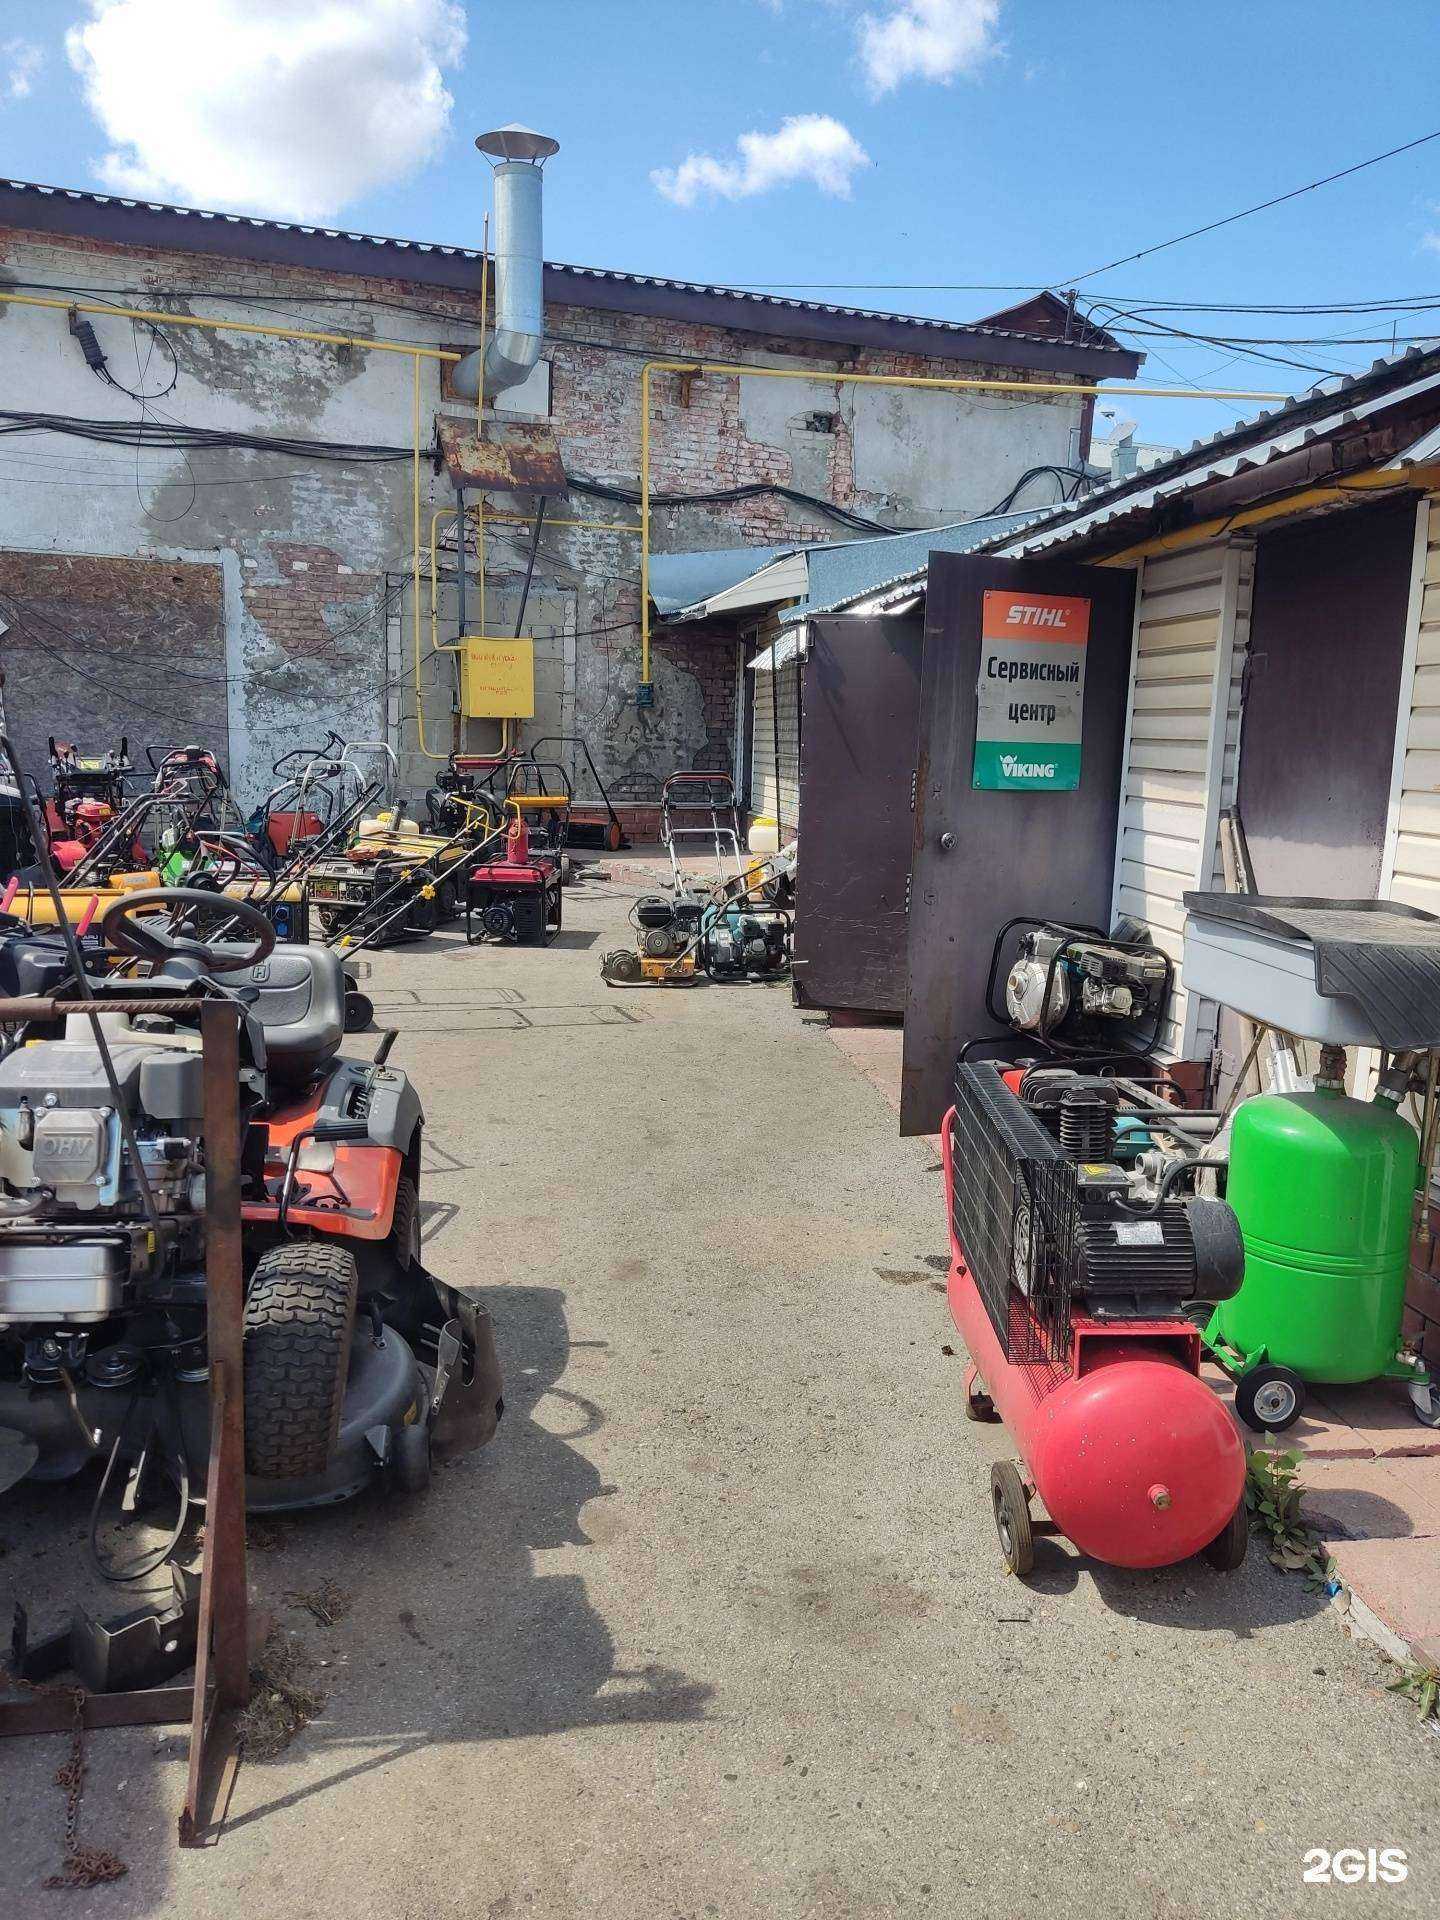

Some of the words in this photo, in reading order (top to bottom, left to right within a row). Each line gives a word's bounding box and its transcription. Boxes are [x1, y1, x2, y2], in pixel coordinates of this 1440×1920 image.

[1006, 605, 1066, 627] STIHL
[988, 656, 1080, 683] Сервисный
[1008, 703, 1056, 725] центр
[1002, 763, 1055, 778] VIKING
